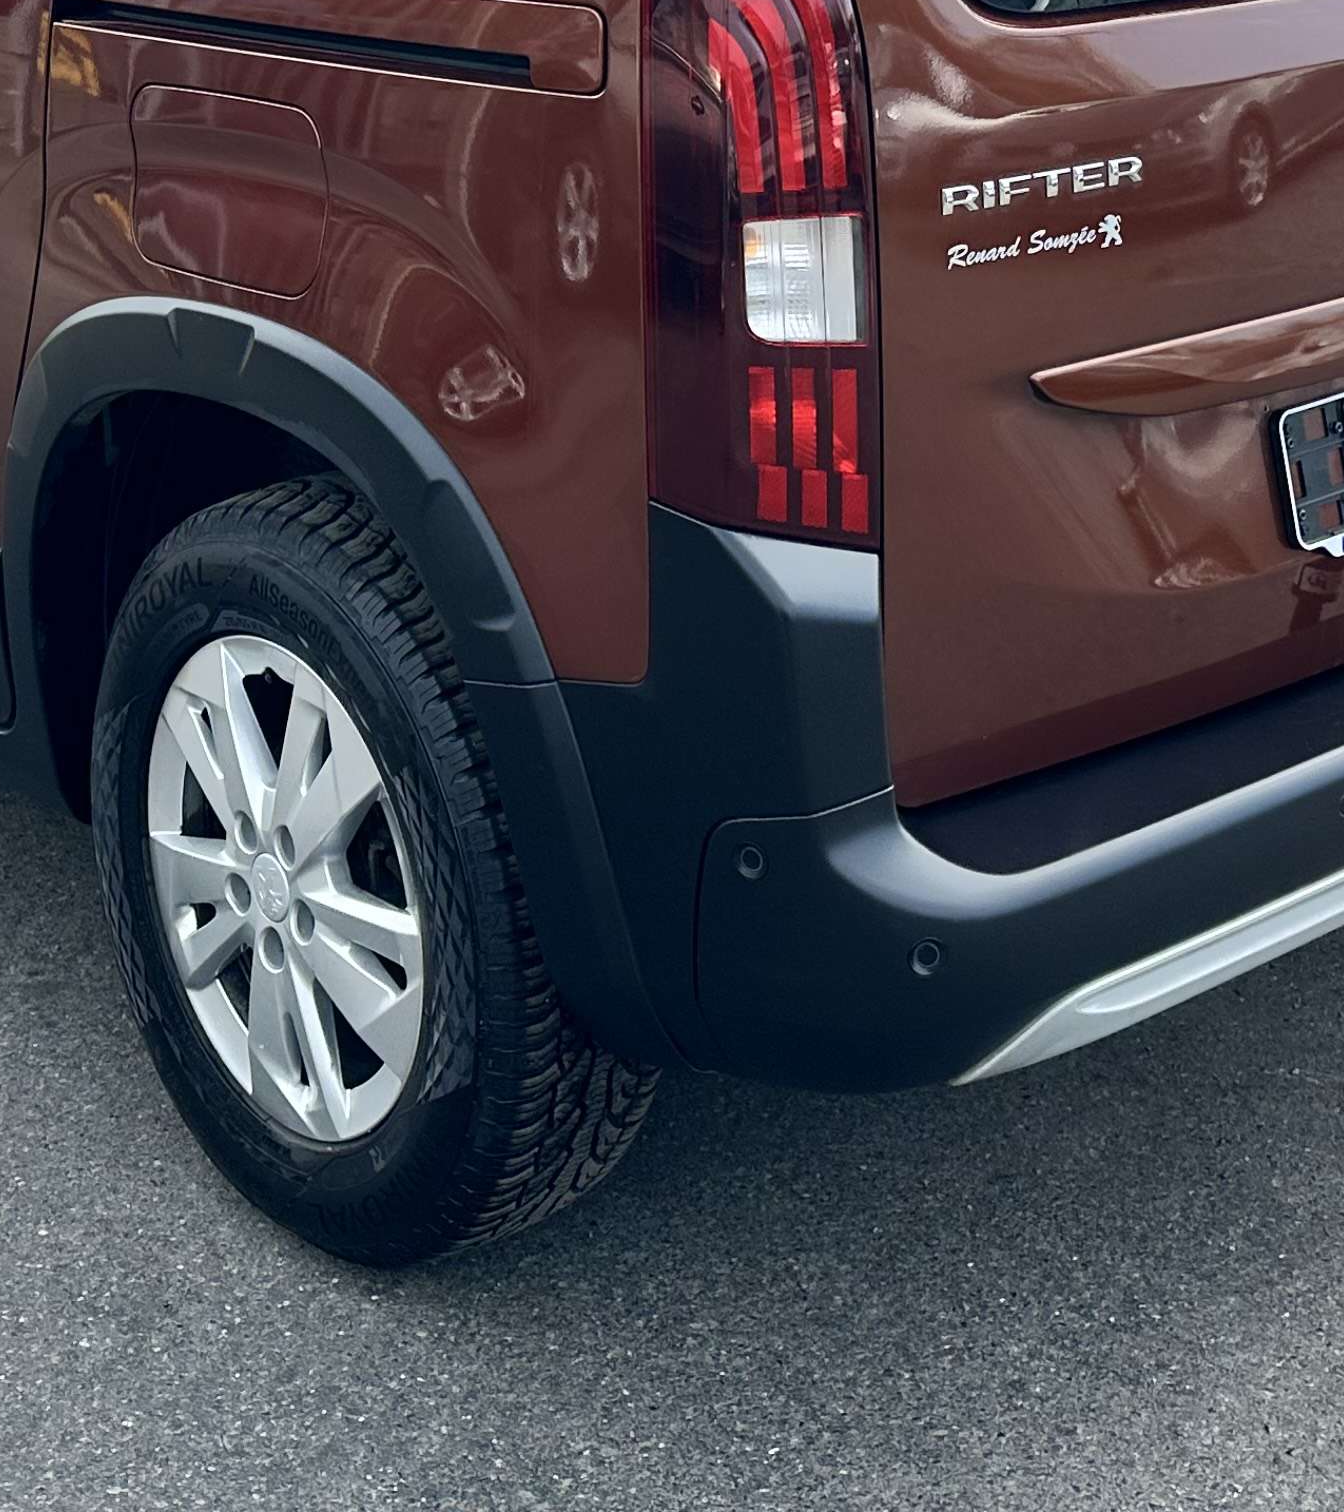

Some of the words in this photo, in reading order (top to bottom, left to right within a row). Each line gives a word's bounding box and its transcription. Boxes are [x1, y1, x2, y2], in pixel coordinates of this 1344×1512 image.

[941, 156, 1143, 216] RIFTER
[947, 236, 1021, 270] Renard
[1027, 225, 1098, 254] Somzée
